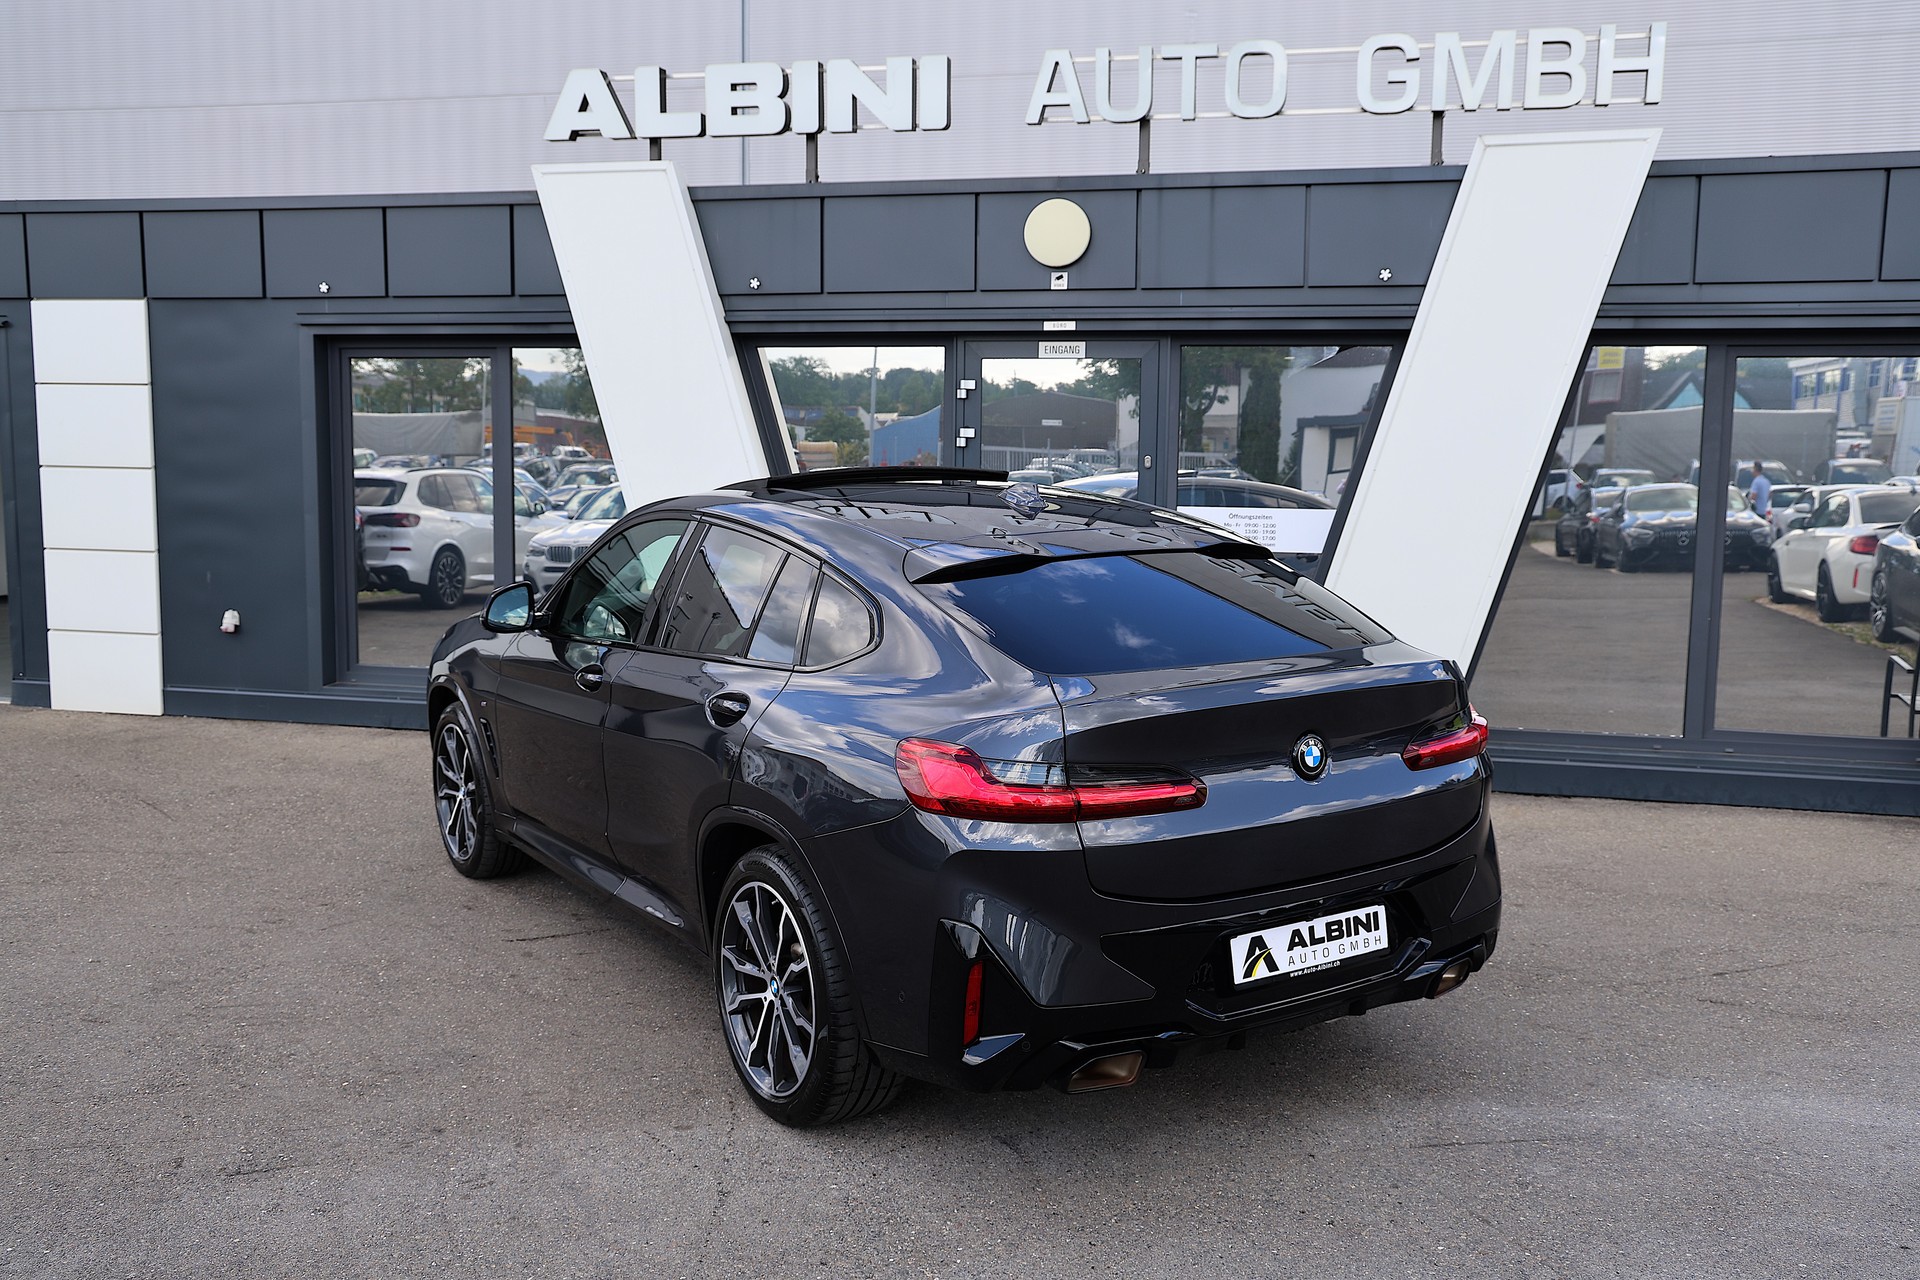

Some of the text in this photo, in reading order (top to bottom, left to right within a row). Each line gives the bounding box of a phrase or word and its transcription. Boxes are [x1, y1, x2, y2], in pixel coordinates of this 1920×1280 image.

[543, 21, 1668, 141] ALBINI AUTO GMBH
[1044, 345, 1080, 354] EINGANG
[1228, 512, 1273, 520] Öffnungszeiten
[1301, 739, 1323, 752] BMW
[1286, 911, 1380, 952] ALBINI
[1288, 935, 1382, 967] AUTO GMBH
[1289, 960, 1341, 978] www.Auto-Albini.ch
